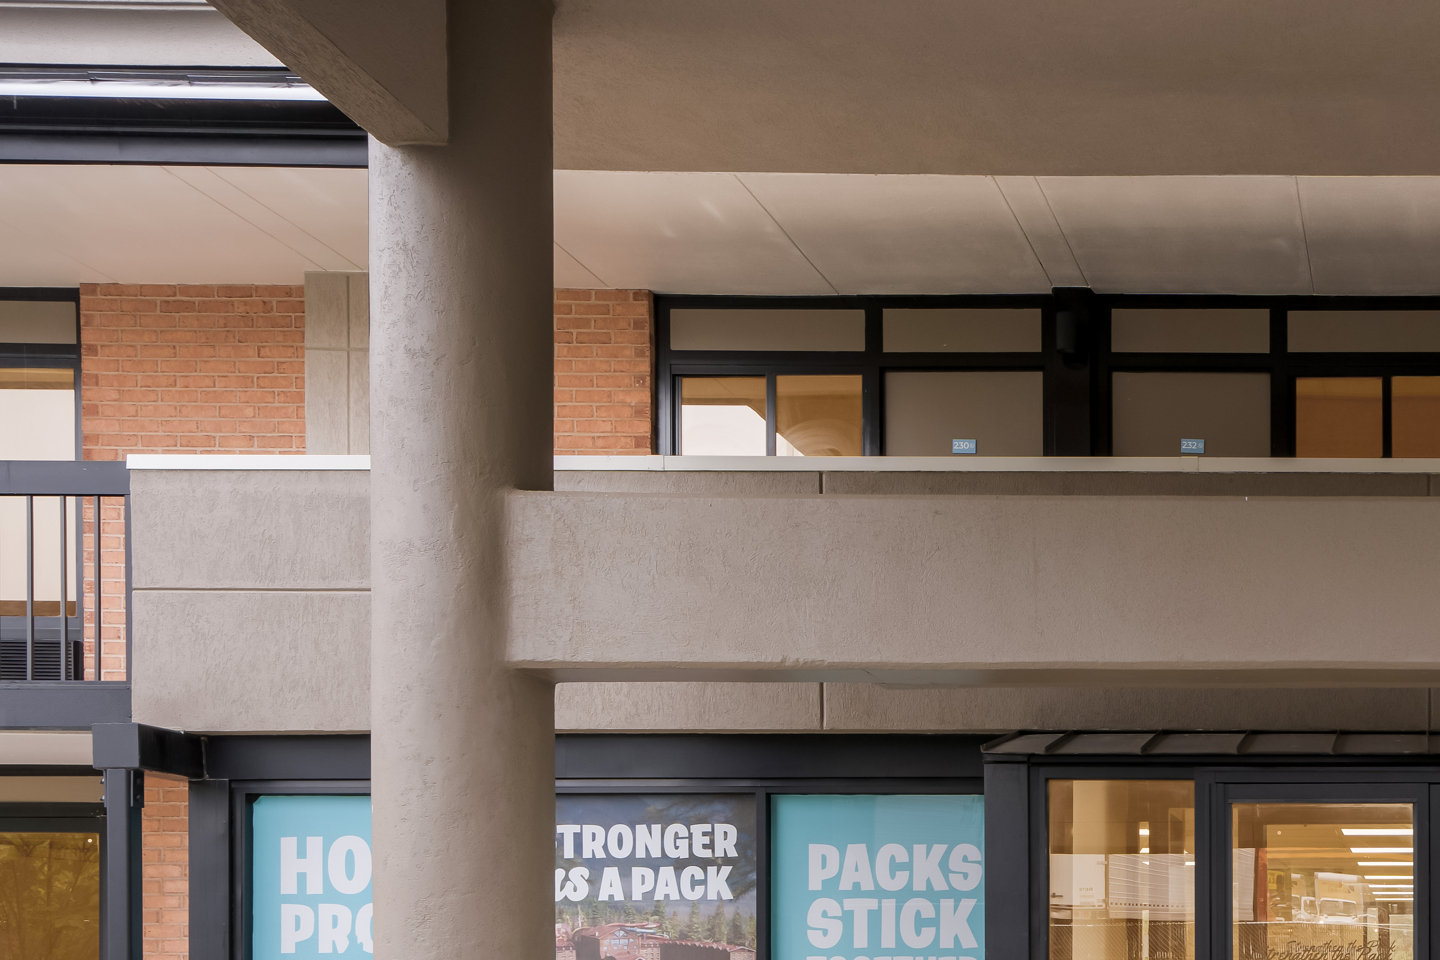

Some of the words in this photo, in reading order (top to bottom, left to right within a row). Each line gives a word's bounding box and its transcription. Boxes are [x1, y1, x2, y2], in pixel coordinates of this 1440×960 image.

[953, 441, 970, 450] 230
[555, 823, 739, 859] TRONGER
[597, 866, 625, 901] A
[631, 865, 734, 901] PACK
[808, 843, 983, 892] PACKS
[807, 897, 979, 949] STICK
